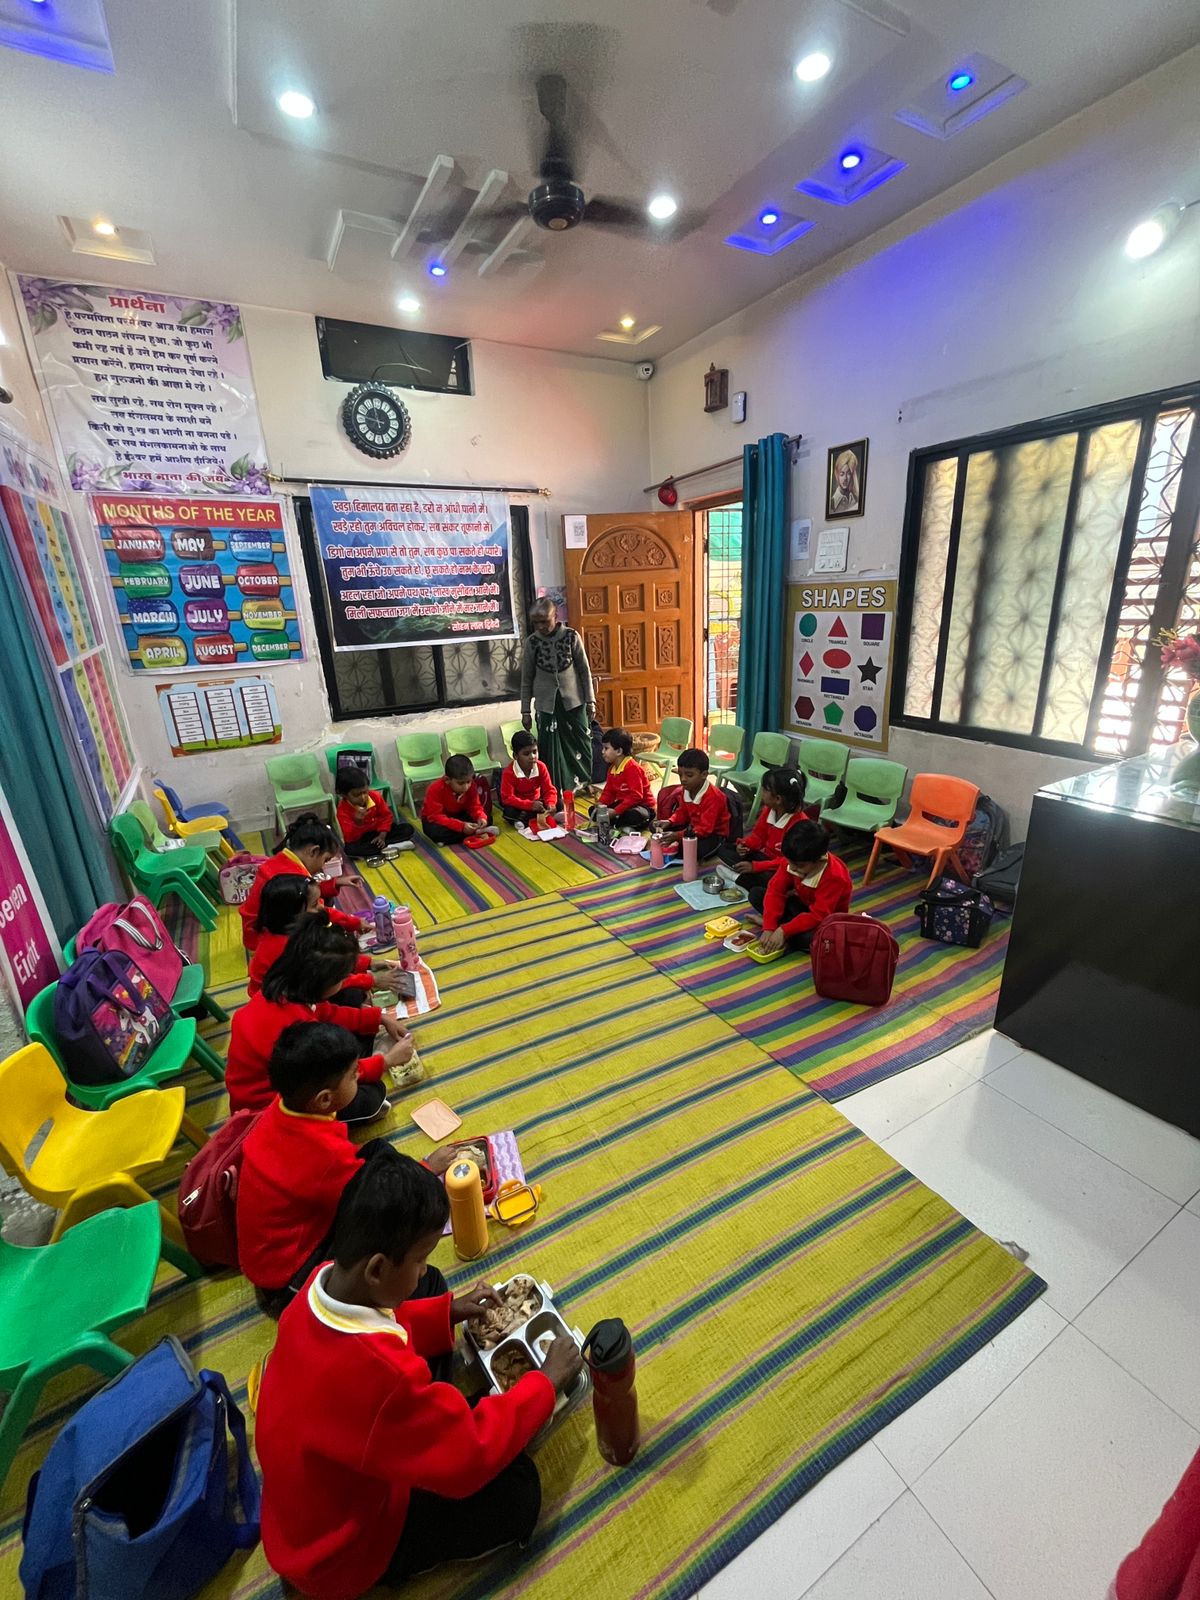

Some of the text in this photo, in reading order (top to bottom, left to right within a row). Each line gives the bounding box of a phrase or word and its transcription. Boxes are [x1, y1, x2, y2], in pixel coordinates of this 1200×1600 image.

[108, 295, 165, 313] प्रार्थना
[73, 312, 114, 323] परमपिता
[156, 322, 174, 331] आज
[176, 325, 188, 333] का
[190, 326, 214, 335] हमारा
[73, 327, 93, 336] पठन
[95, 329, 119, 338] पाठन
[172, 337, 183, 346] जो
[202, 340, 213, 350] भी
[72, 341, 93, 350] कमी
[95, 344, 108, 353] रह
[110, 344, 125, 355] गई
[152, 350, 165, 359] हम
[183, 353, 197, 364] पूर्ण
[199, 355, 218, 364] करने
[72, 356, 98, 365] प्रयास
[128, 362, 154, 371] हमारा
[156, 364, 187, 375] मनोबल
[94, 373, 108, 382] हम
[147, 377, 159, 386] की
[91, 395, 107, 403] सब
[109, 396, 130, 407] सुखी
[149, 400, 164, 408] सब
[166, 399, 182, 409] रोग
[184, 403, 204, 413] मुक्त
[165, 413, 174, 422] के
[113, 423, 125, 433] को
[161, 428, 183, 437] भागी
[106, 439, 119, 447] इन
[200, 442, 208, 451] के
[123, 471, 152, 480] भारत
[156, 473, 182, 481] माता
[186, 473, 201, 481] की
[102, 503, 276, 522] MONTHS OF THE YEAR
[353, 499, 384, 511] हिमालय
[386, 502, 398, 511] बता
[401, 503, 412, 512] रहा
[423, 501, 434, 513] डरो
[436, 504, 442, 512] न
[461, 503, 477, 513] पानी
[349, 519, 362, 531] रहो
[365, 522, 376, 534] तुम
[380, 519, 405, 531] अविचल
[429, 523, 440, 532] सब
[116, 539, 161, 550] JANUARY
[176, 538, 206, 552] MAY
[230, 541, 271, 551] SEPTEMBER
[346, 548, 353, 557] न
[354, 546, 374, 557] अपने
[376, 548, 388, 557] प्रण
[390, 545, 398, 556] से
[399, 545, 407, 556] तो
[424, 547, 434, 556] सब
[436, 547, 448, 559] कुछ
[450, 547, 457, 555] पा
[458, 545, 475, 555] सकते
[477, 545, 484, 555] हो
[341, 567, 354, 579] तुम
[356, 564, 366, 576] भी
[382, 567, 392, 575] उठ
[393, 565, 412, 575] सकते
[424, 566, 431, 578] छू
[432, 564, 449, 574] सकते
[450, 564, 457, 574] हो
[472, 563, 480, 574] के
[124, 575, 169, 586] FEBRUARY
[184, 575, 221, 589] JUNE
[237, 575, 279, 586] OCTOBER
[362, 590, 375, 600] रहा
[376, 587, 386, 599] जो
[388, 586, 406, 599] अपने
[801, 586, 887, 608] SHAPES
[133, 611, 177, 623] MARCH
[191, 609, 223, 623] JULY
[243, 611, 282, 619] NOVEMBER
[346, 606, 366, 619] मिली
[368, 607, 397, 618] सफलता
[398, 607, 410, 616] जग
[146, 646, 180, 659] APRIL
[196, 644, 234, 656] AUGUST
[252, 643, 289, 652] DECEMBER
